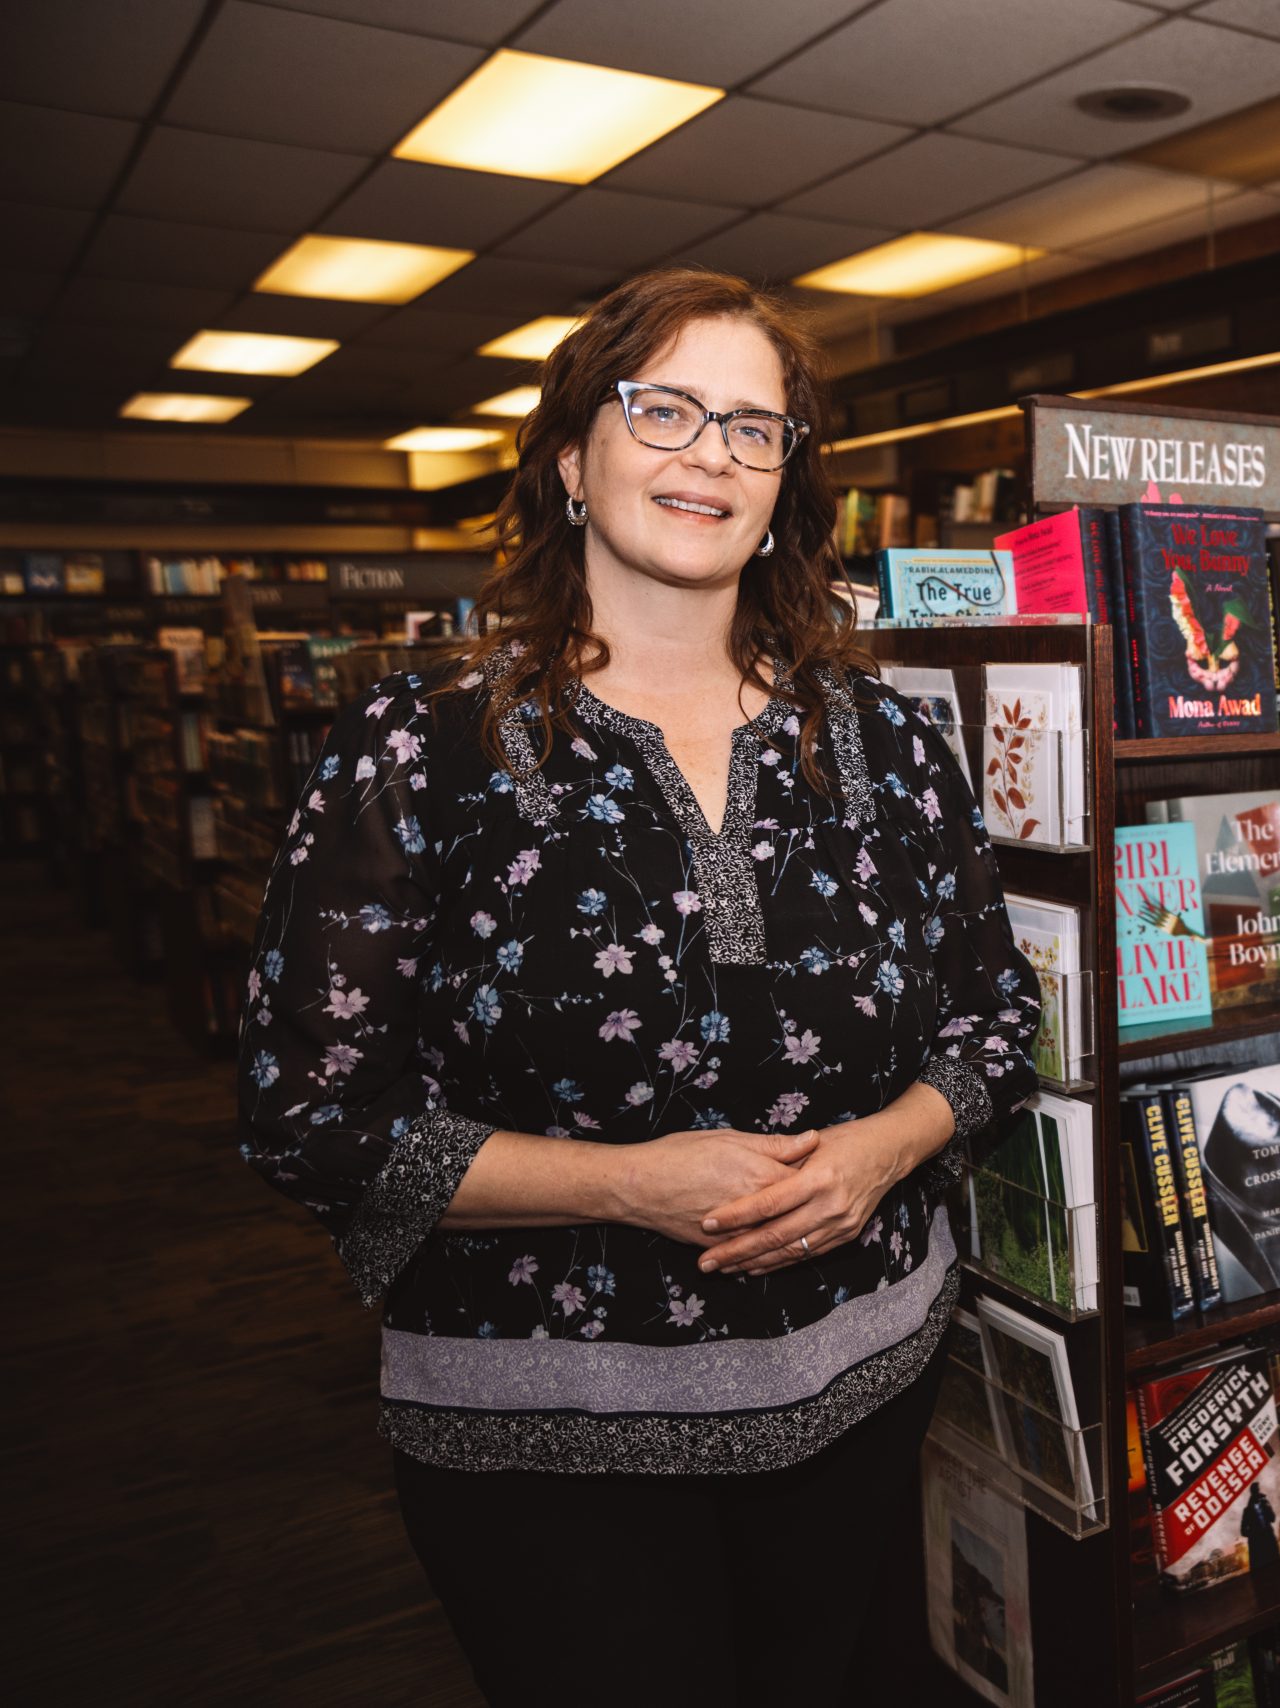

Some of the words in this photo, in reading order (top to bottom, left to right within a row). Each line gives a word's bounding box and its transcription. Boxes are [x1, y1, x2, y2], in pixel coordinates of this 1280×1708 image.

[1141, 439, 1267, 488] RELEASES
[1171, 522, 1197, 546] We
[1199, 523, 1239, 548] Love
[908, 566, 936, 574] RABIH
[937, 566, 995, 575] ALAMEDDINE
[1199, 549, 1251, 577] Bunny
[916, 583, 947, 601] The
[954, 583, 992, 601] True
[1168, 695, 1215, 719] Mona
[1217, 692, 1262, 717] Awad
[1231, 819, 1275, 843] The
[1146, 1104, 1169, 1153] CLIVE
[1175, 1097, 1197, 1145] CLIVE
[1153, 1152, 1181, 1228] CUSSLER
[1182, 1146, 1208, 1220] CUSSLER
[1165, 1371, 1271, 1487] FORSYTH
[1167, 1363, 1252, 1453] FREDERICK
[1255, 1414, 1271, 1434] TONY
[1258, 1420, 1276, 1441] KENT
[1174, 1434, 1256, 1523] REVENGE
[1184, 1522, 1197, 1537] OF
[1191, 1448, 1265, 1530] ODESSA
